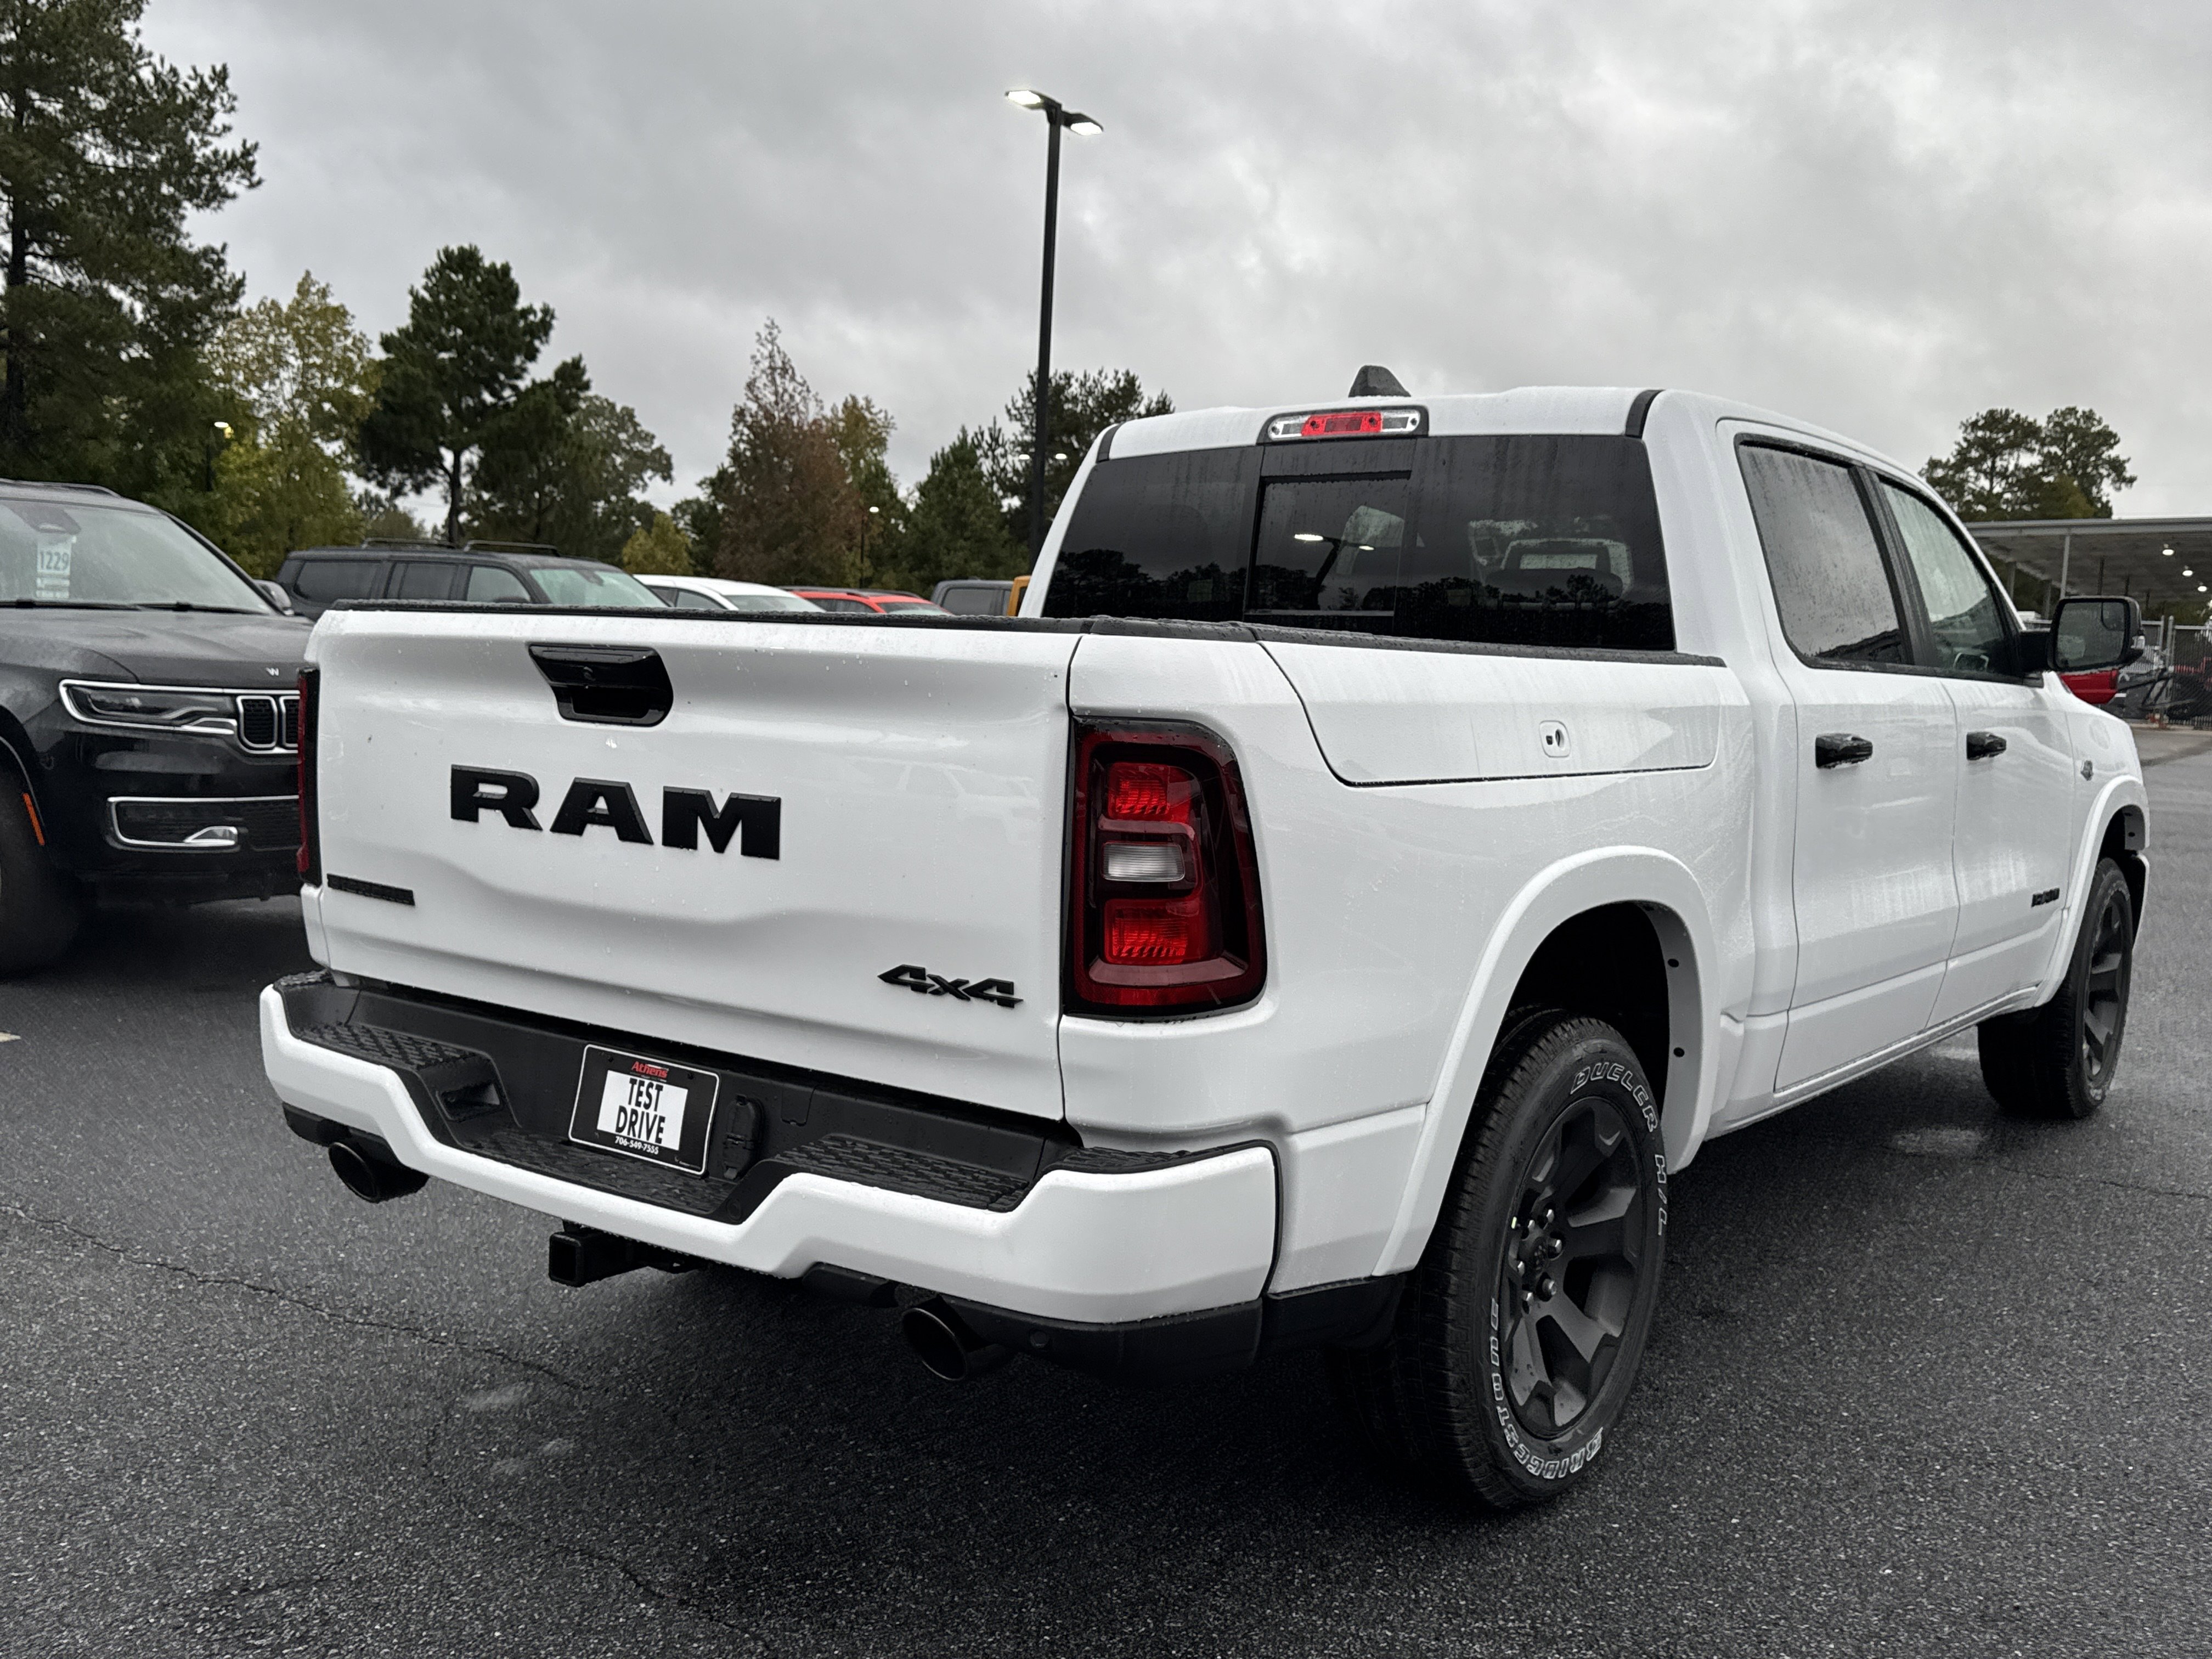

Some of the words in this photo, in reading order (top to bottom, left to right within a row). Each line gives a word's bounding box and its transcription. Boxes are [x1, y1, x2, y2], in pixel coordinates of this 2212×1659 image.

[40, 550, 69, 570] 1229
[451, 764, 781, 860] RAM
[631, 1061, 668, 1079] Athens
[628, 1077, 664, 1112] TEST
[1570, 1062, 1658, 1132] DUELER
[615, 1105, 666, 1144] DRIVE
[614, 1136, 659, 1155] 706-549-7555
[1490, 1298, 1603, 1479] BRIDGESTONE
